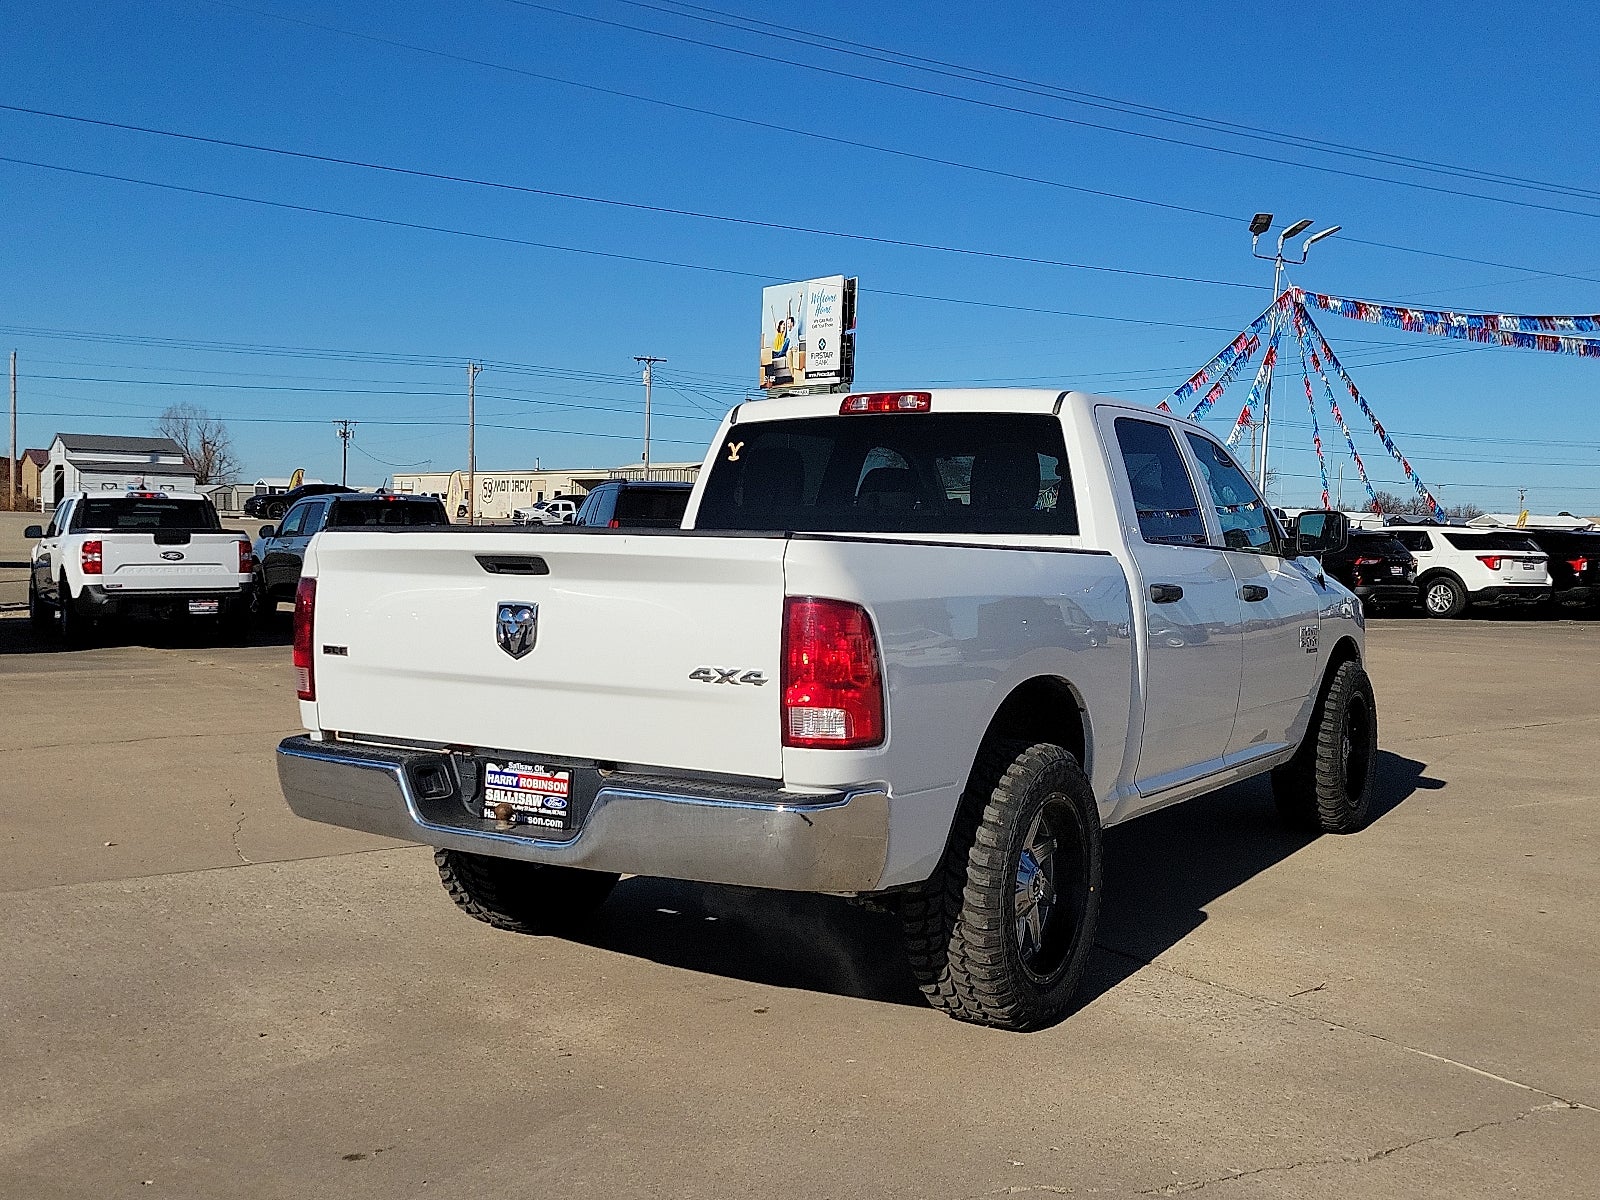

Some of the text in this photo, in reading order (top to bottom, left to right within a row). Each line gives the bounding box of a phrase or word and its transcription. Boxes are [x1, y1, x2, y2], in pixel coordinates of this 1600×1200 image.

[487, 773, 568, 793] HARRY ROBINSON
[485, 788, 544, 808] SALLISAW
